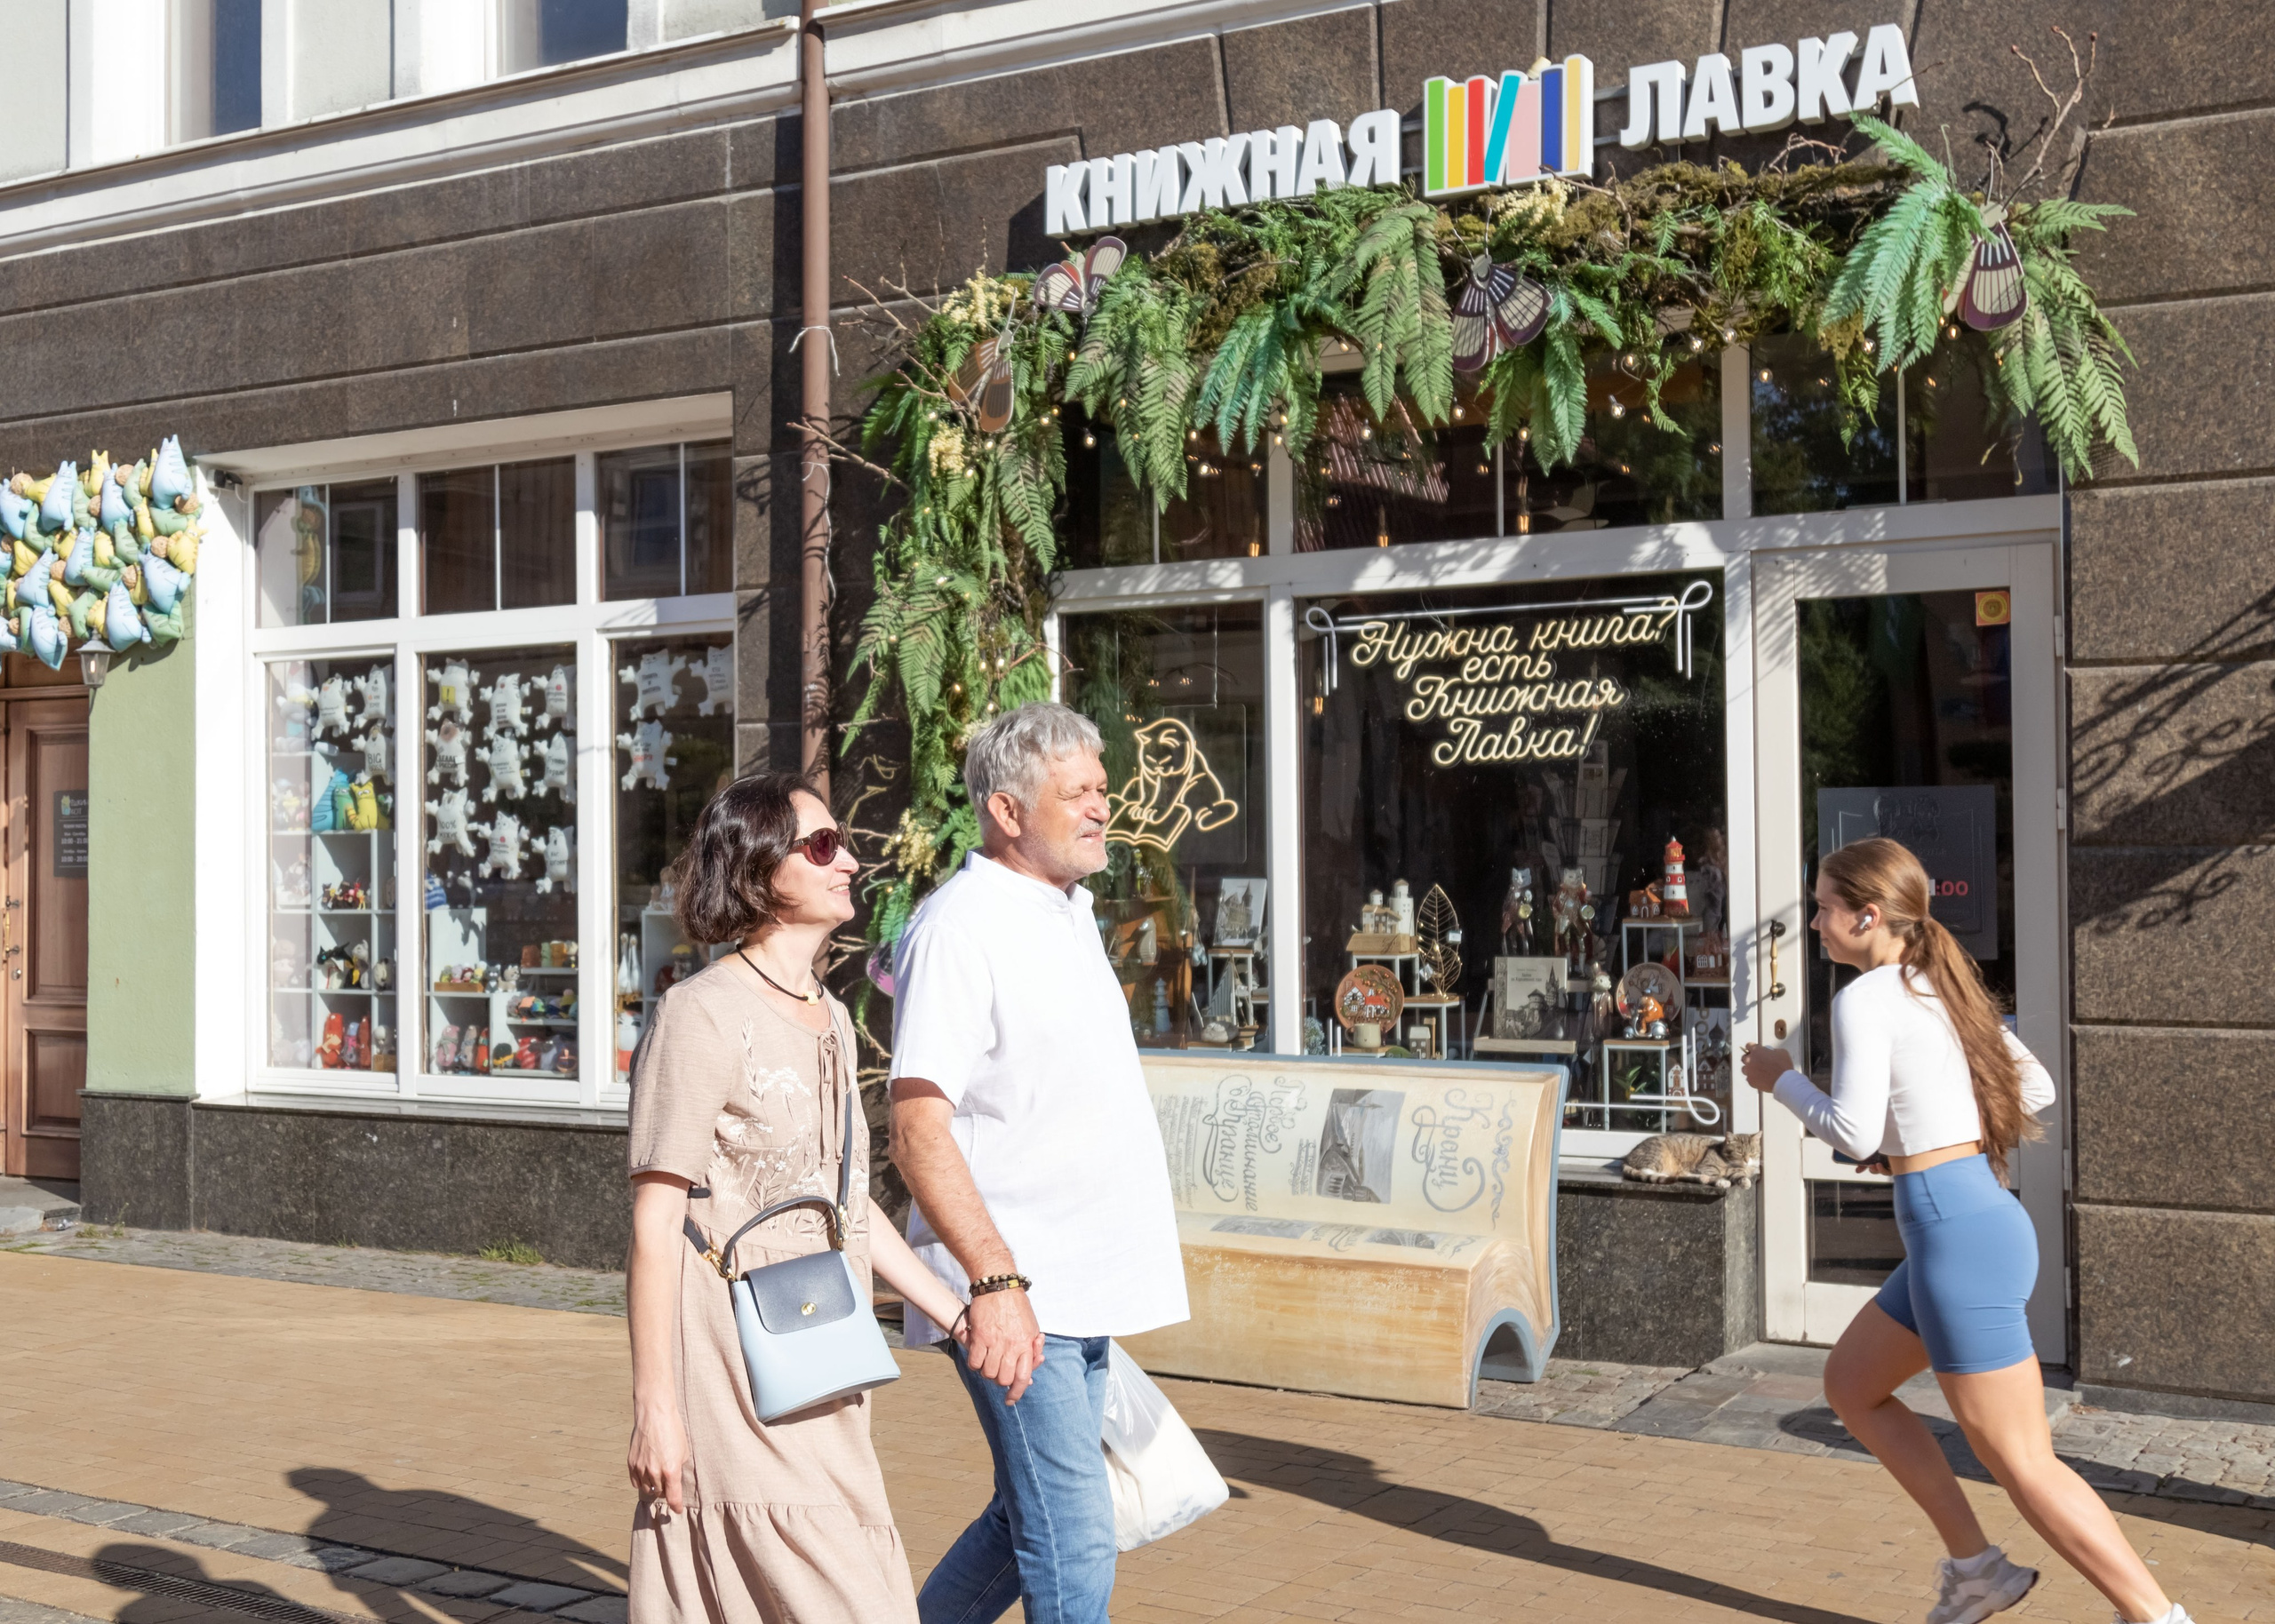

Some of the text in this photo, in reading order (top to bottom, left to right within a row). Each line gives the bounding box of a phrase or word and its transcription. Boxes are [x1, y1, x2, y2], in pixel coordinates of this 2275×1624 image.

[1046, 23, 1919, 237] КНИЖНАЯ ЛАВКА
[1350, 598, 1678, 681] Нужна книга?
[1461, 651, 1553, 683] есть
[1407, 673, 1626, 720] Книжная
[367, 753, 382, 764] BIG
[1433, 714, 1599, 767] Лавка!
[1929, 880, 1968, 896] :00
[1209, 1098, 1248, 1197] Кранце
[1243, 1092, 1266, 1212] упоминание
[1258, 1076, 1306, 1153] Первое
[1411, 1087, 1493, 1199] Кранц
